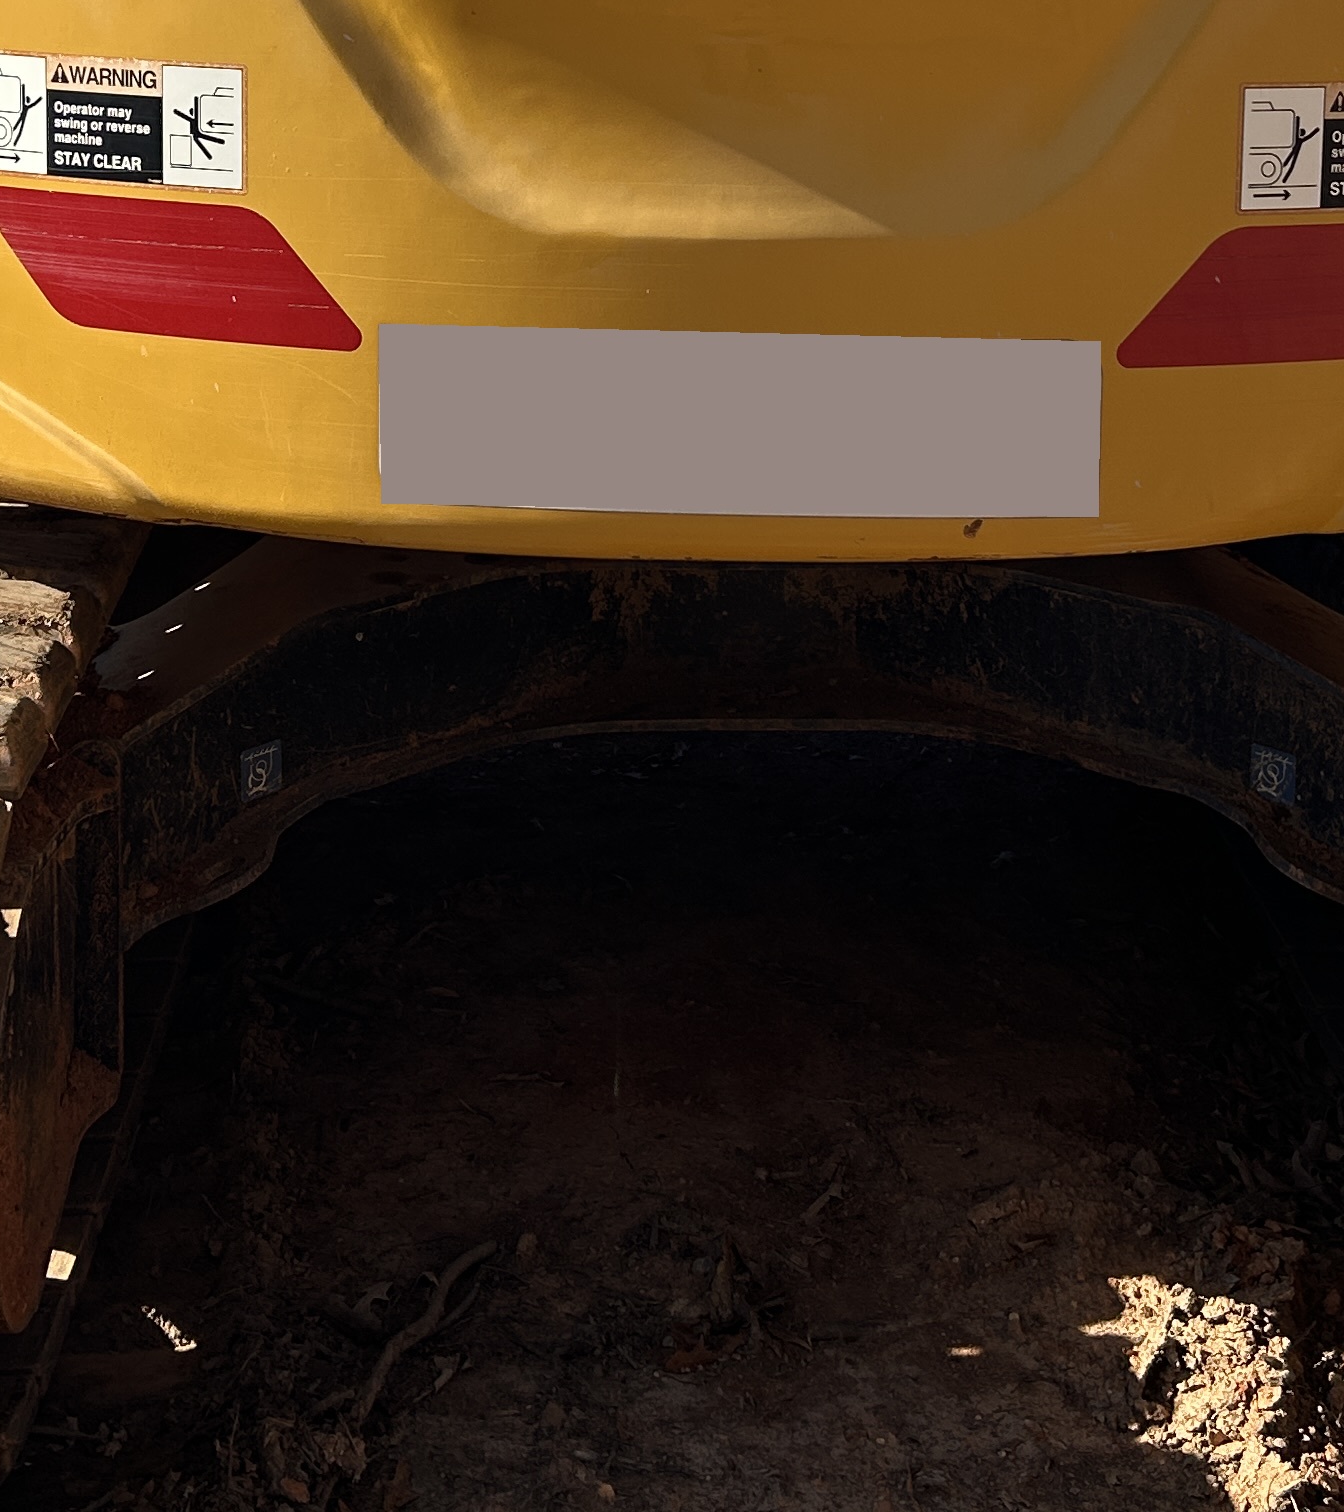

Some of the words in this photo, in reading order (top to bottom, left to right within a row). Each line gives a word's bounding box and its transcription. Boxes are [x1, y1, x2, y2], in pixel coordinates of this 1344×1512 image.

[70, 66, 157, 89] WARNING
[54, 102, 104, 116] Operator
[108, 107, 132, 120] may
[54, 118, 88, 132] swing
[90, 121, 104, 131] or
[106, 122, 150, 134] reverse
[54, 132, 102, 146] machine
[54, 151, 90, 167] STAY
[94, 154, 142, 171] CLEAR
